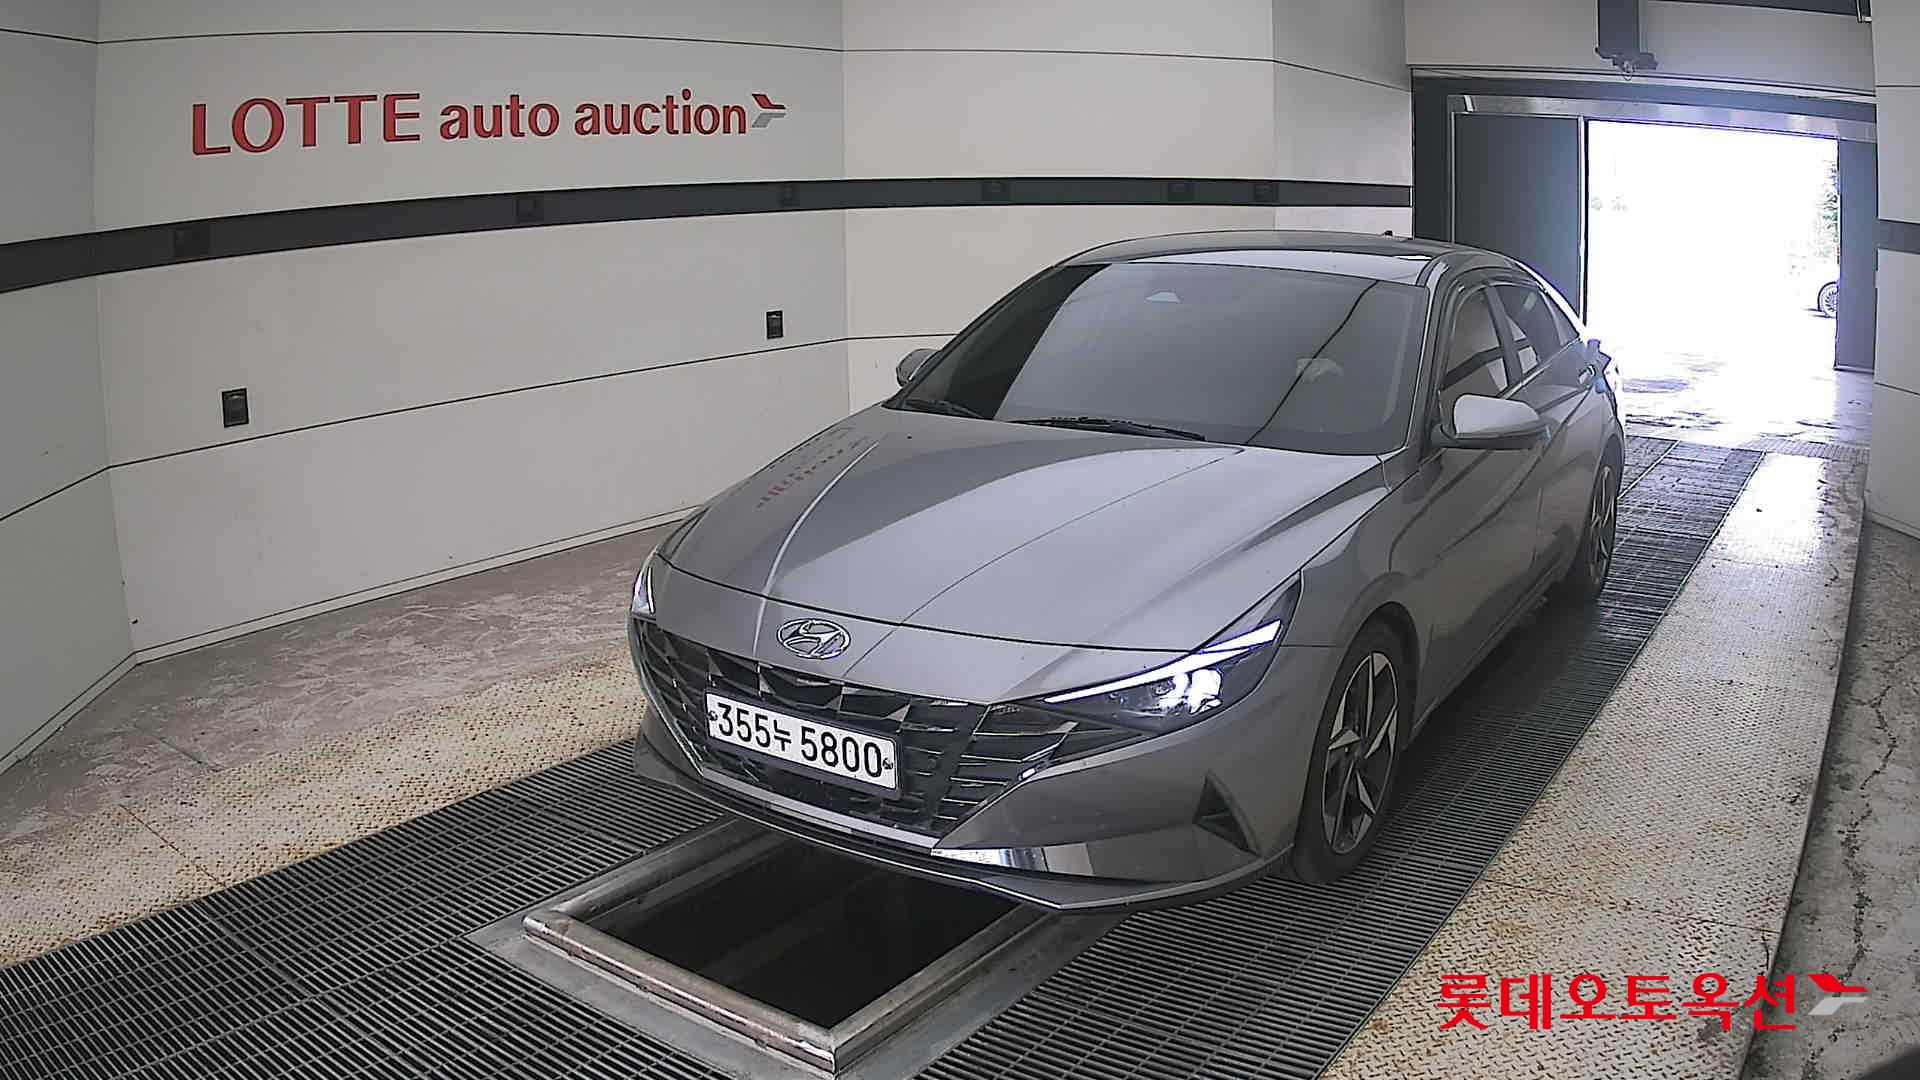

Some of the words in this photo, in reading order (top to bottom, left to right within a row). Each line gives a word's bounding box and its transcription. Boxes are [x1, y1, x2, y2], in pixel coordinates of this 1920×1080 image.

[192, 93, 421, 156] LOTTE
[438, 94, 560, 141] auto
[573, 88, 748, 136] auction
[717, 702, 792, 751] 355누
[801, 726, 882, 777] 5800
